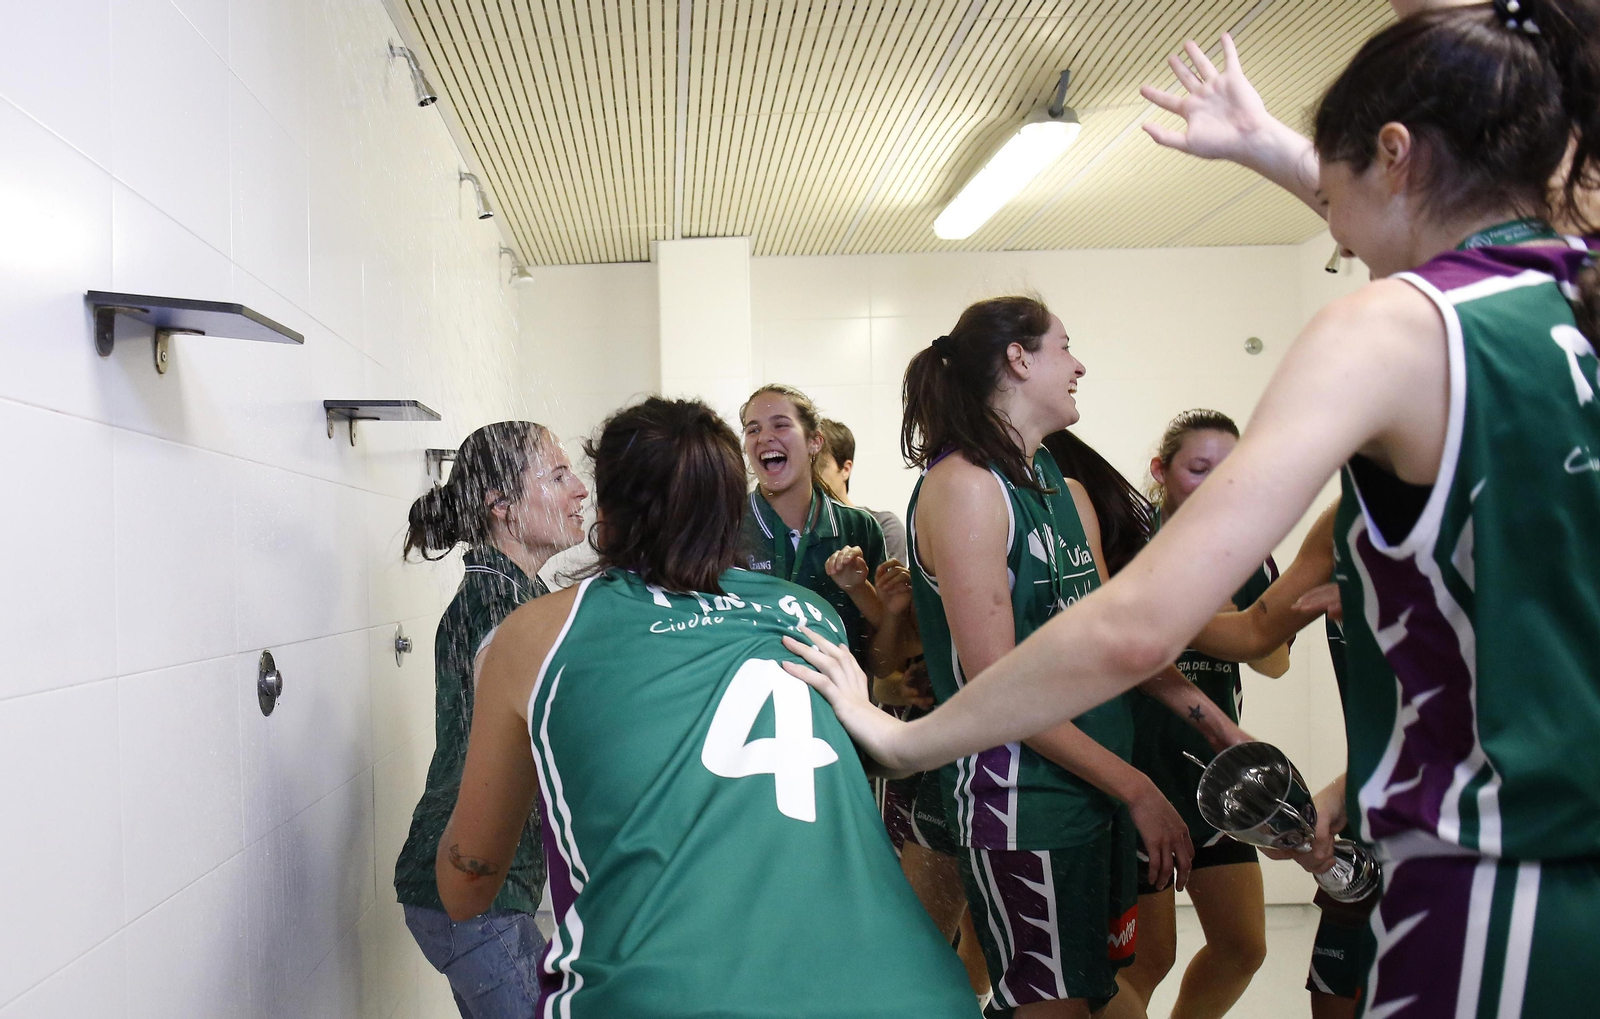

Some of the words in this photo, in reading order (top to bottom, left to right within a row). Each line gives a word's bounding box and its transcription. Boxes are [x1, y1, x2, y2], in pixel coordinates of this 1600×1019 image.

[1177, 661, 1191, 672] STA
[1192, 661, 1212, 671] DEL
[701, 658, 839, 822] 4
